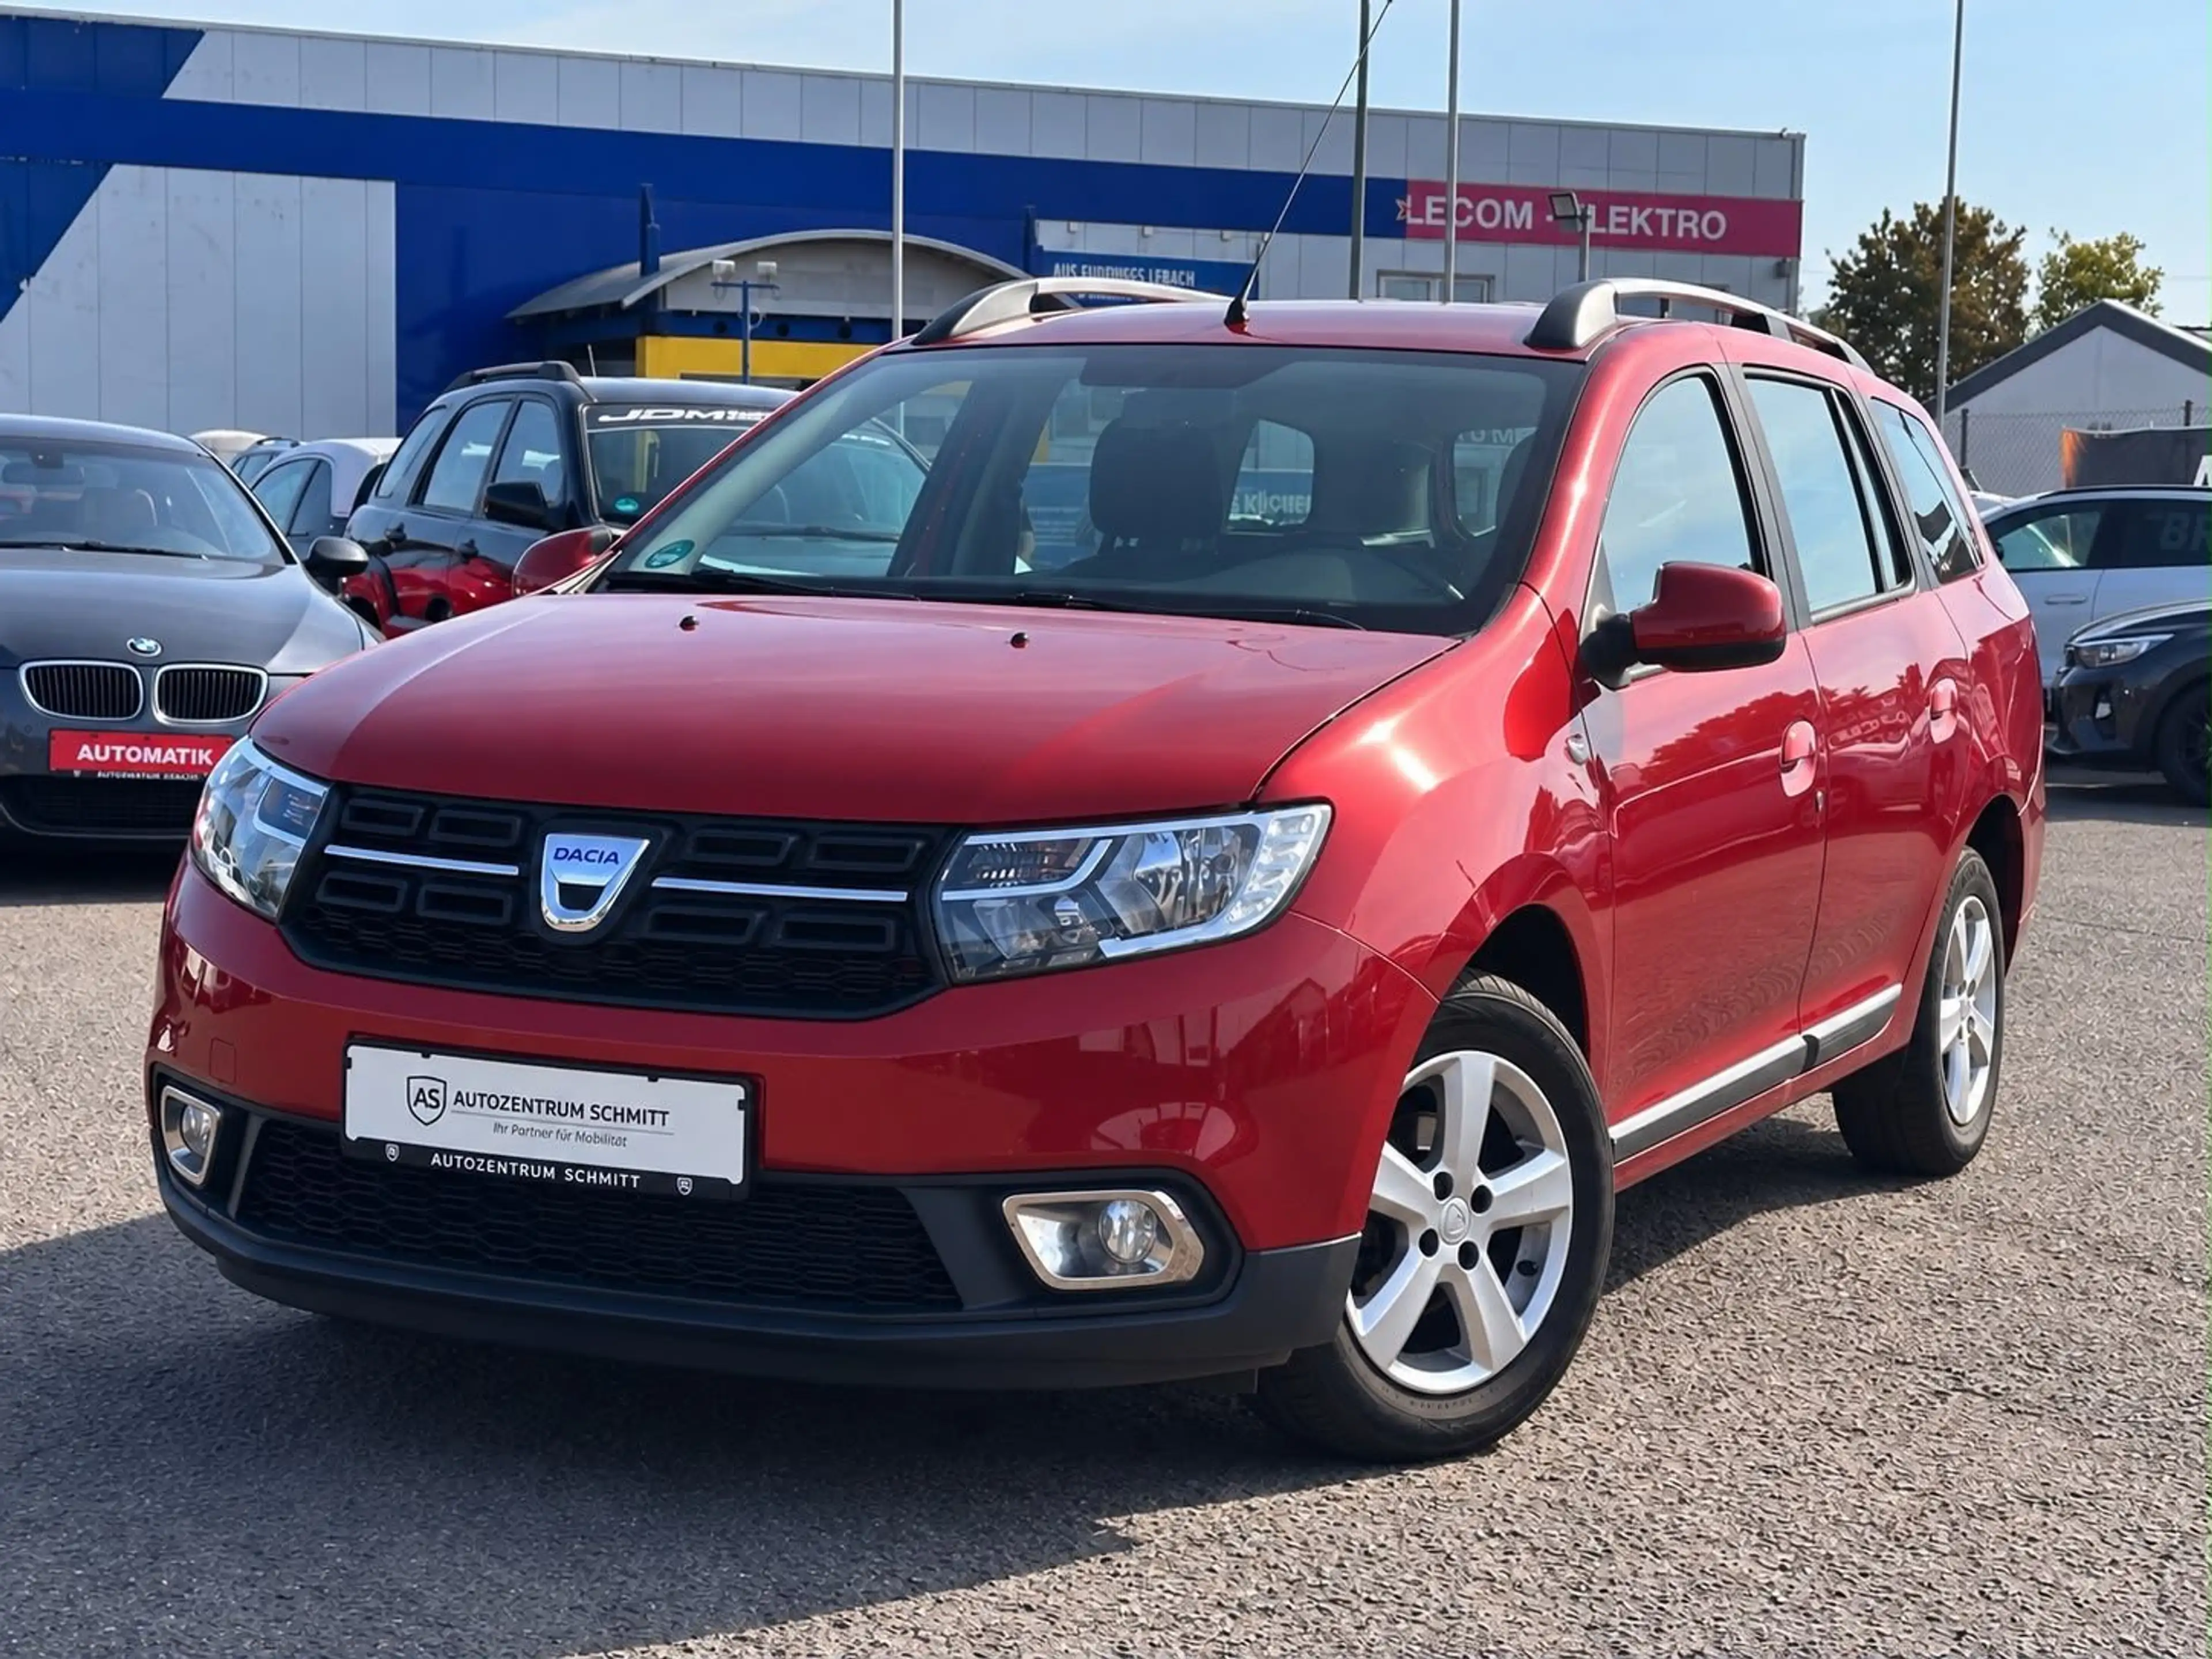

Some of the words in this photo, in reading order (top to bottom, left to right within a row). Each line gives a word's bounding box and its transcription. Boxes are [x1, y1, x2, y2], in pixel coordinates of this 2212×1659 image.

[77, 744, 214, 766] AUTOMATIK
[553, 847, 619, 865] DACIA
[413, 1088, 441, 1109] AS
[453, 1091, 584, 1119] AUTOZENTRUM
[590, 1104, 670, 1127] SCHMITT
[493, 1122, 508, 1135] Ihr
[511, 1124, 552, 1139] Partner
[431, 1153, 555, 1179] AUTOZENTRUM
[565, 1168, 641, 1188] SCHMITT
